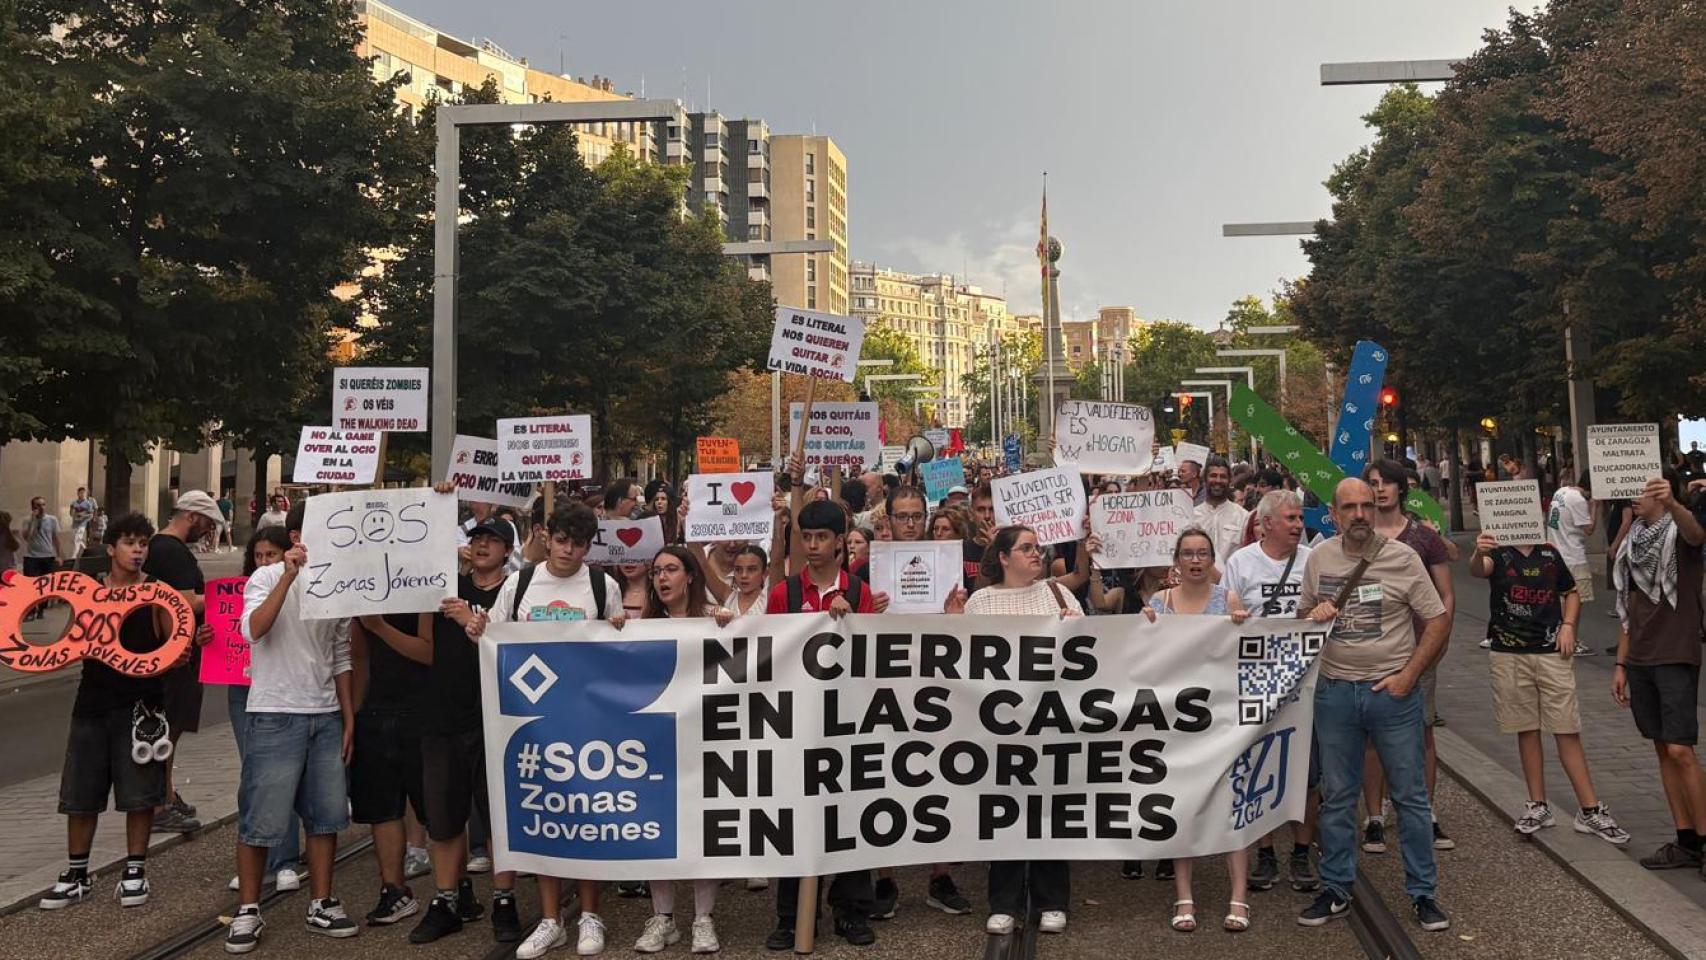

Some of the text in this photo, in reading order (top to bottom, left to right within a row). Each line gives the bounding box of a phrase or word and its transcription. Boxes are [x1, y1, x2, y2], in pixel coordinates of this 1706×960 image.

[791, 315, 846, 335] ES LITERAL
[782, 328, 849, 351] NOS QUIEREN
[792, 347, 829, 363] QUITAR
[769, 358, 844, 381] LA VIDA SOCIAL
[340, 376, 422, 390] SI QUERÉIS ZOMBIES
[363, 397, 394, 410] OS VÉIS
[829, 409, 871, 420] QUITÁIS
[340, 418, 418, 430] THE WALKING DEAD
[513, 423, 573, 434] ES LITERAL
[1070, 416, 1088, 435] ES
[1591, 424, 1655, 433] AYUNTAMIENTO
[311, 431, 375, 441] NO AL GAME
[810, 426, 853, 437] EL OCIO,
[507, 440, 530, 450] NOS
[823, 439, 865, 450] QUITÁIS
[1608, 436, 1651, 445] ZARAGOZA
[304, 444, 376, 454] OVER AL OCIO
[1603, 449, 1646, 457] MALTRATA
[322, 458, 353, 467] EN LA
[522, 454, 561, 465] QUITAR
[822, 453, 865, 465] SUEÑOS
[1593, 462, 1660, 473] EDUCADORAS/ES
[316, 471, 355, 480] CIUDAD
[502, 469, 583, 481] LA VIDA SOCIAL
[1620, 475, 1647, 484] ZONAS
[452, 472, 531, 498] OCIO NOT FOUND
[1011, 474, 1068, 498] JUVENTUD
[1480, 484, 1537, 493] AYUNTAMIENTO
[707, 483, 722, 505] I
[1005, 487, 1075, 516] NECESITA SER
[1103, 492, 1174, 510] HORIZON CON
[1496, 497, 1534, 505] ZARAGOZA
[1106, 511, 1136, 525] ZONA
[1493, 509, 1528, 517] MARGINA
[690, 521, 770, 537] ZONA JOVEN
[1502, 521, 1539, 530] JUVENTUD
[592, 528, 608, 546] I
[306, 552, 448, 602] Zonas Jóvenes
[92, 584, 137, 603] CASAS
[219, 601, 235, 614] DE
[69, 609, 122, 645] SOS
[703, 632, 1098, 684] NI CIERRES
[702, 686, 1212, 741] EN LAS CASAS
[703, 739, 1168, 798] NI RECORTES
[519, 782, 637, 813] Zonas
[522, 814, 661, 841] Jovenes
[703, 793, 1178, 857] EN LOS PIEES
